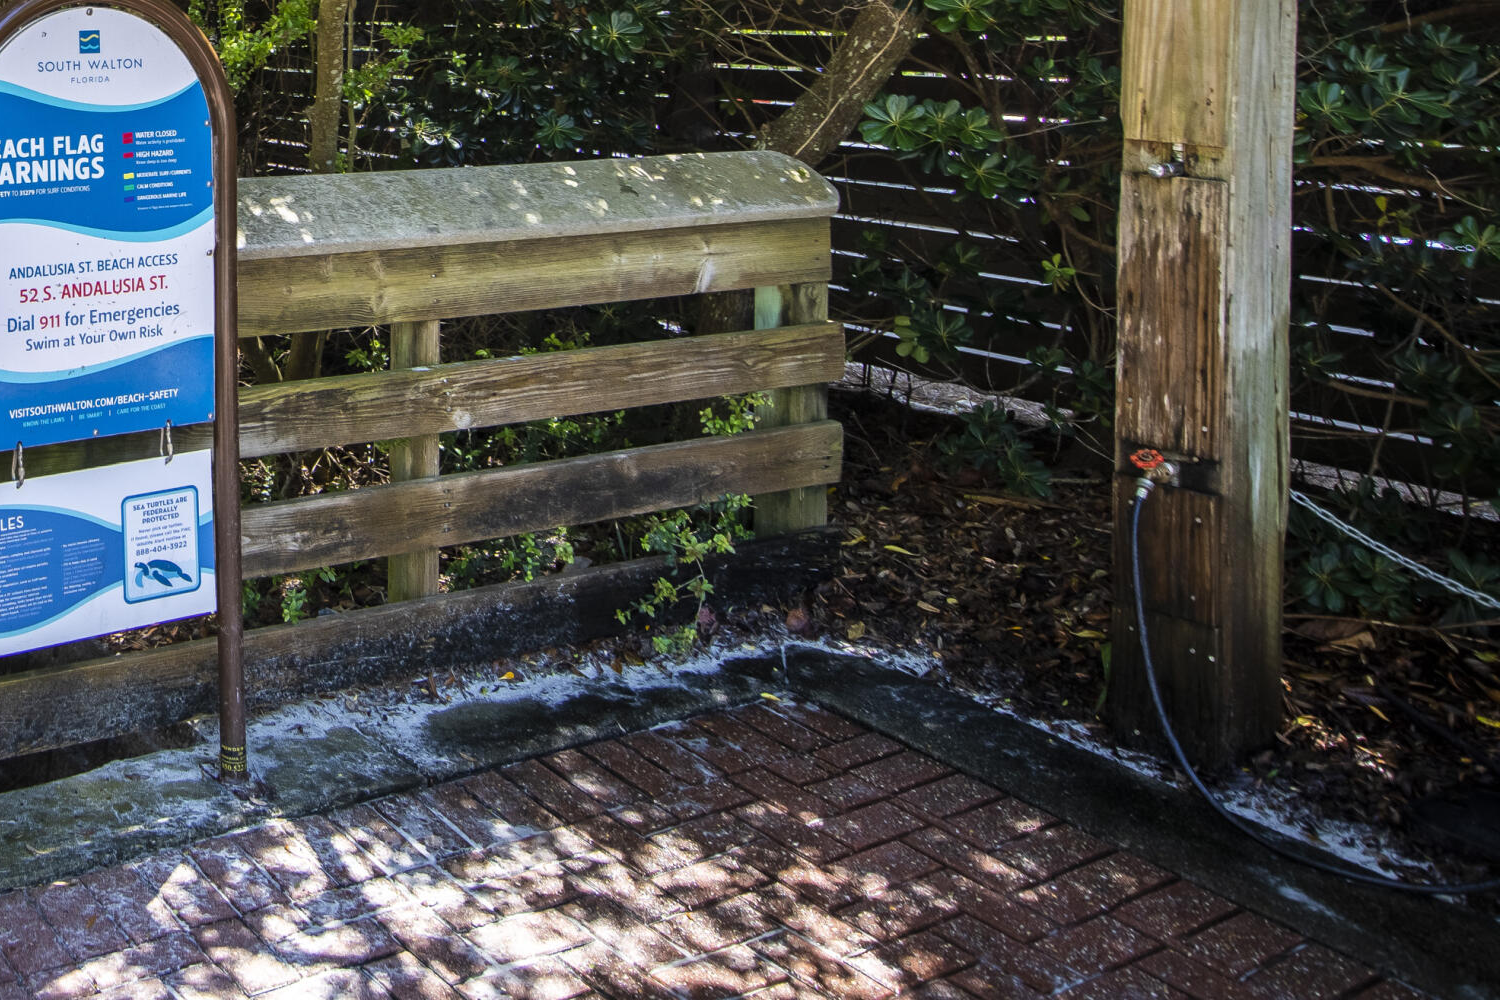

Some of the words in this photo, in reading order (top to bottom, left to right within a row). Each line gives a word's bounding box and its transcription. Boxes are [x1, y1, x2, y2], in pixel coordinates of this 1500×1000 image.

[37, 60, 81, 72] SOUTH
[88, 58, 142, 69] WALTON
[71, 76, 110, 84] FLORIDA
[53, 134, 104, 155] FLAG
[151, 149, 174, 157] HAZARD
[60, 185, 90, 193] CONDITIONS
[9, 262, 75, 280] ANDALUSIA
[78, 261, 94, 274] ST.
[97, 257, 134, 272] BEACH
[137, 253, 178, 268] ACCESS
[19, 288, 38, 304] 52
[43, 285, 56, 301] S.
[62, 277, 146, 300] ANDALUSIA
[149, 275, 168, 290] ST.
[7, 315, 35, 333] Dial
[39, 315, 60, 330] 911
[65, 311, 86, 327] for
[89, 301, 180, 326] Emergencies
[25, 338, 60, 352] Swim
[63, 334, 75, 347] at
[79, 331, 108, 345] Your
[109, 329, 136, 341] Own
[139, 324, 163, 339] Risk
[9, 388, 178, 419] VISITSOUTHWALTON.COM/BEACH-SAFETY
[86, 411, 103, 419] SMART
[117, 407, 129, 415] CARE
[130, 406, 140, 414] FOR
[151, 403, 166, 411] COAST
[143, 505, 178, 516] FEDERALLY
[147, 499, 174, 508] TURTLES
[142, 513, 179, 524] PROTECTED
[136, 541, 187, 556] 888-404-3922
